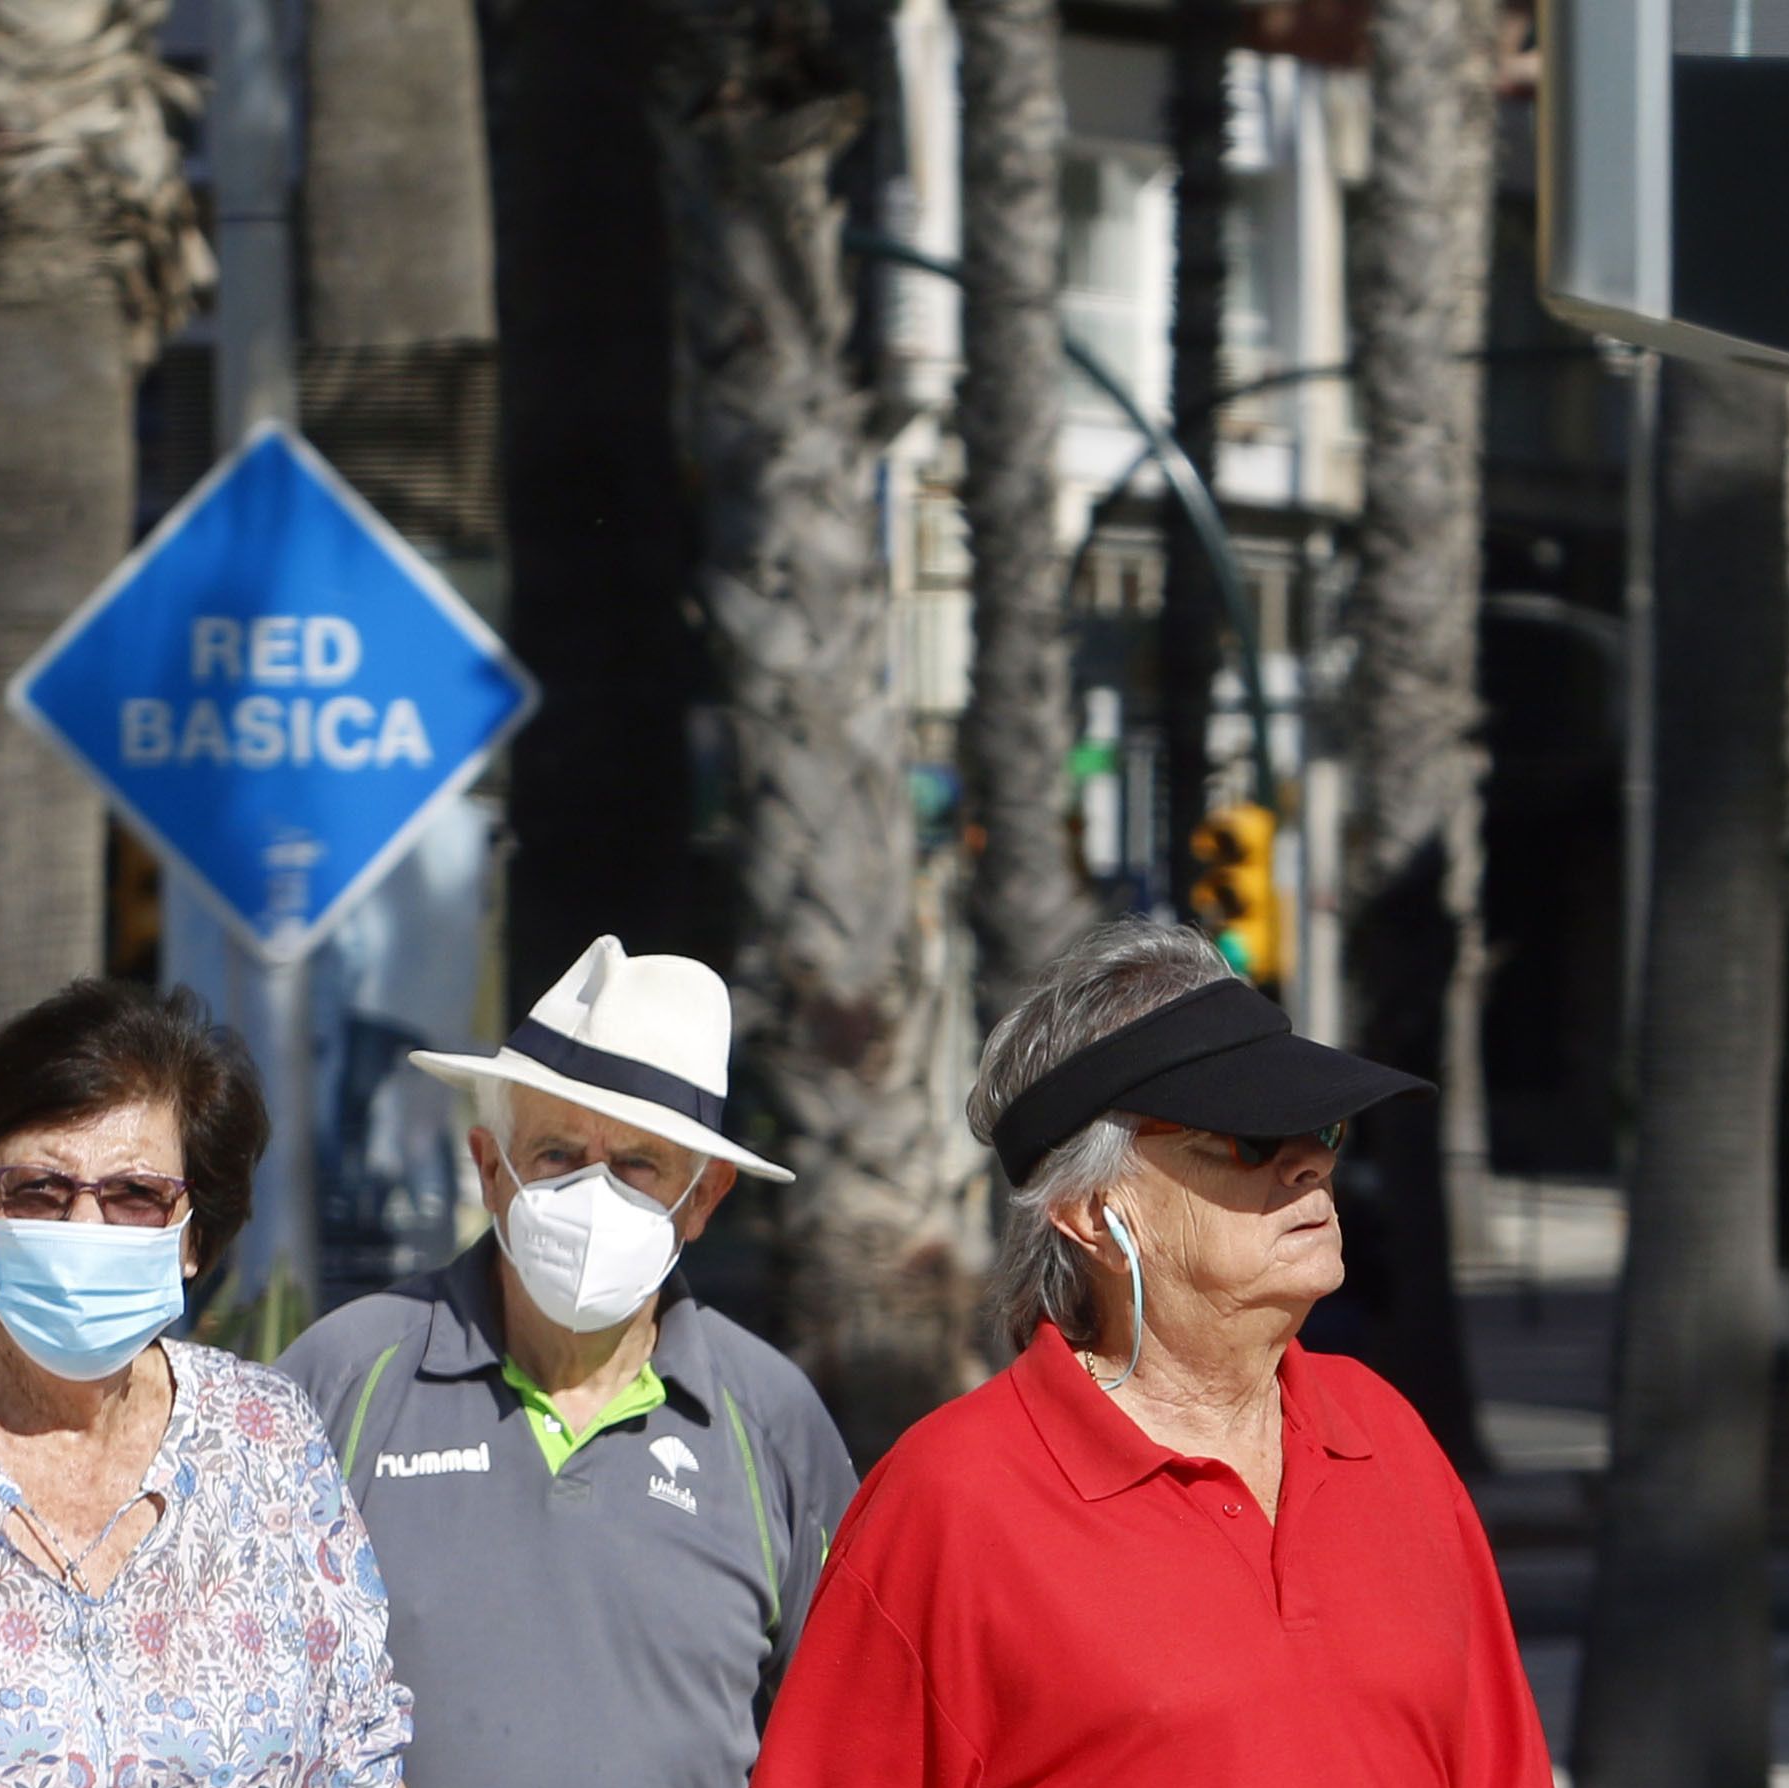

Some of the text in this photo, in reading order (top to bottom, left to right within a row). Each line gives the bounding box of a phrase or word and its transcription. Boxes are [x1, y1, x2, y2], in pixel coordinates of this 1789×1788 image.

[191, 614, 363, 688] RED
[119, 695, 435, 772] BASICA
[375, 1441, 491, 1478] hummel
